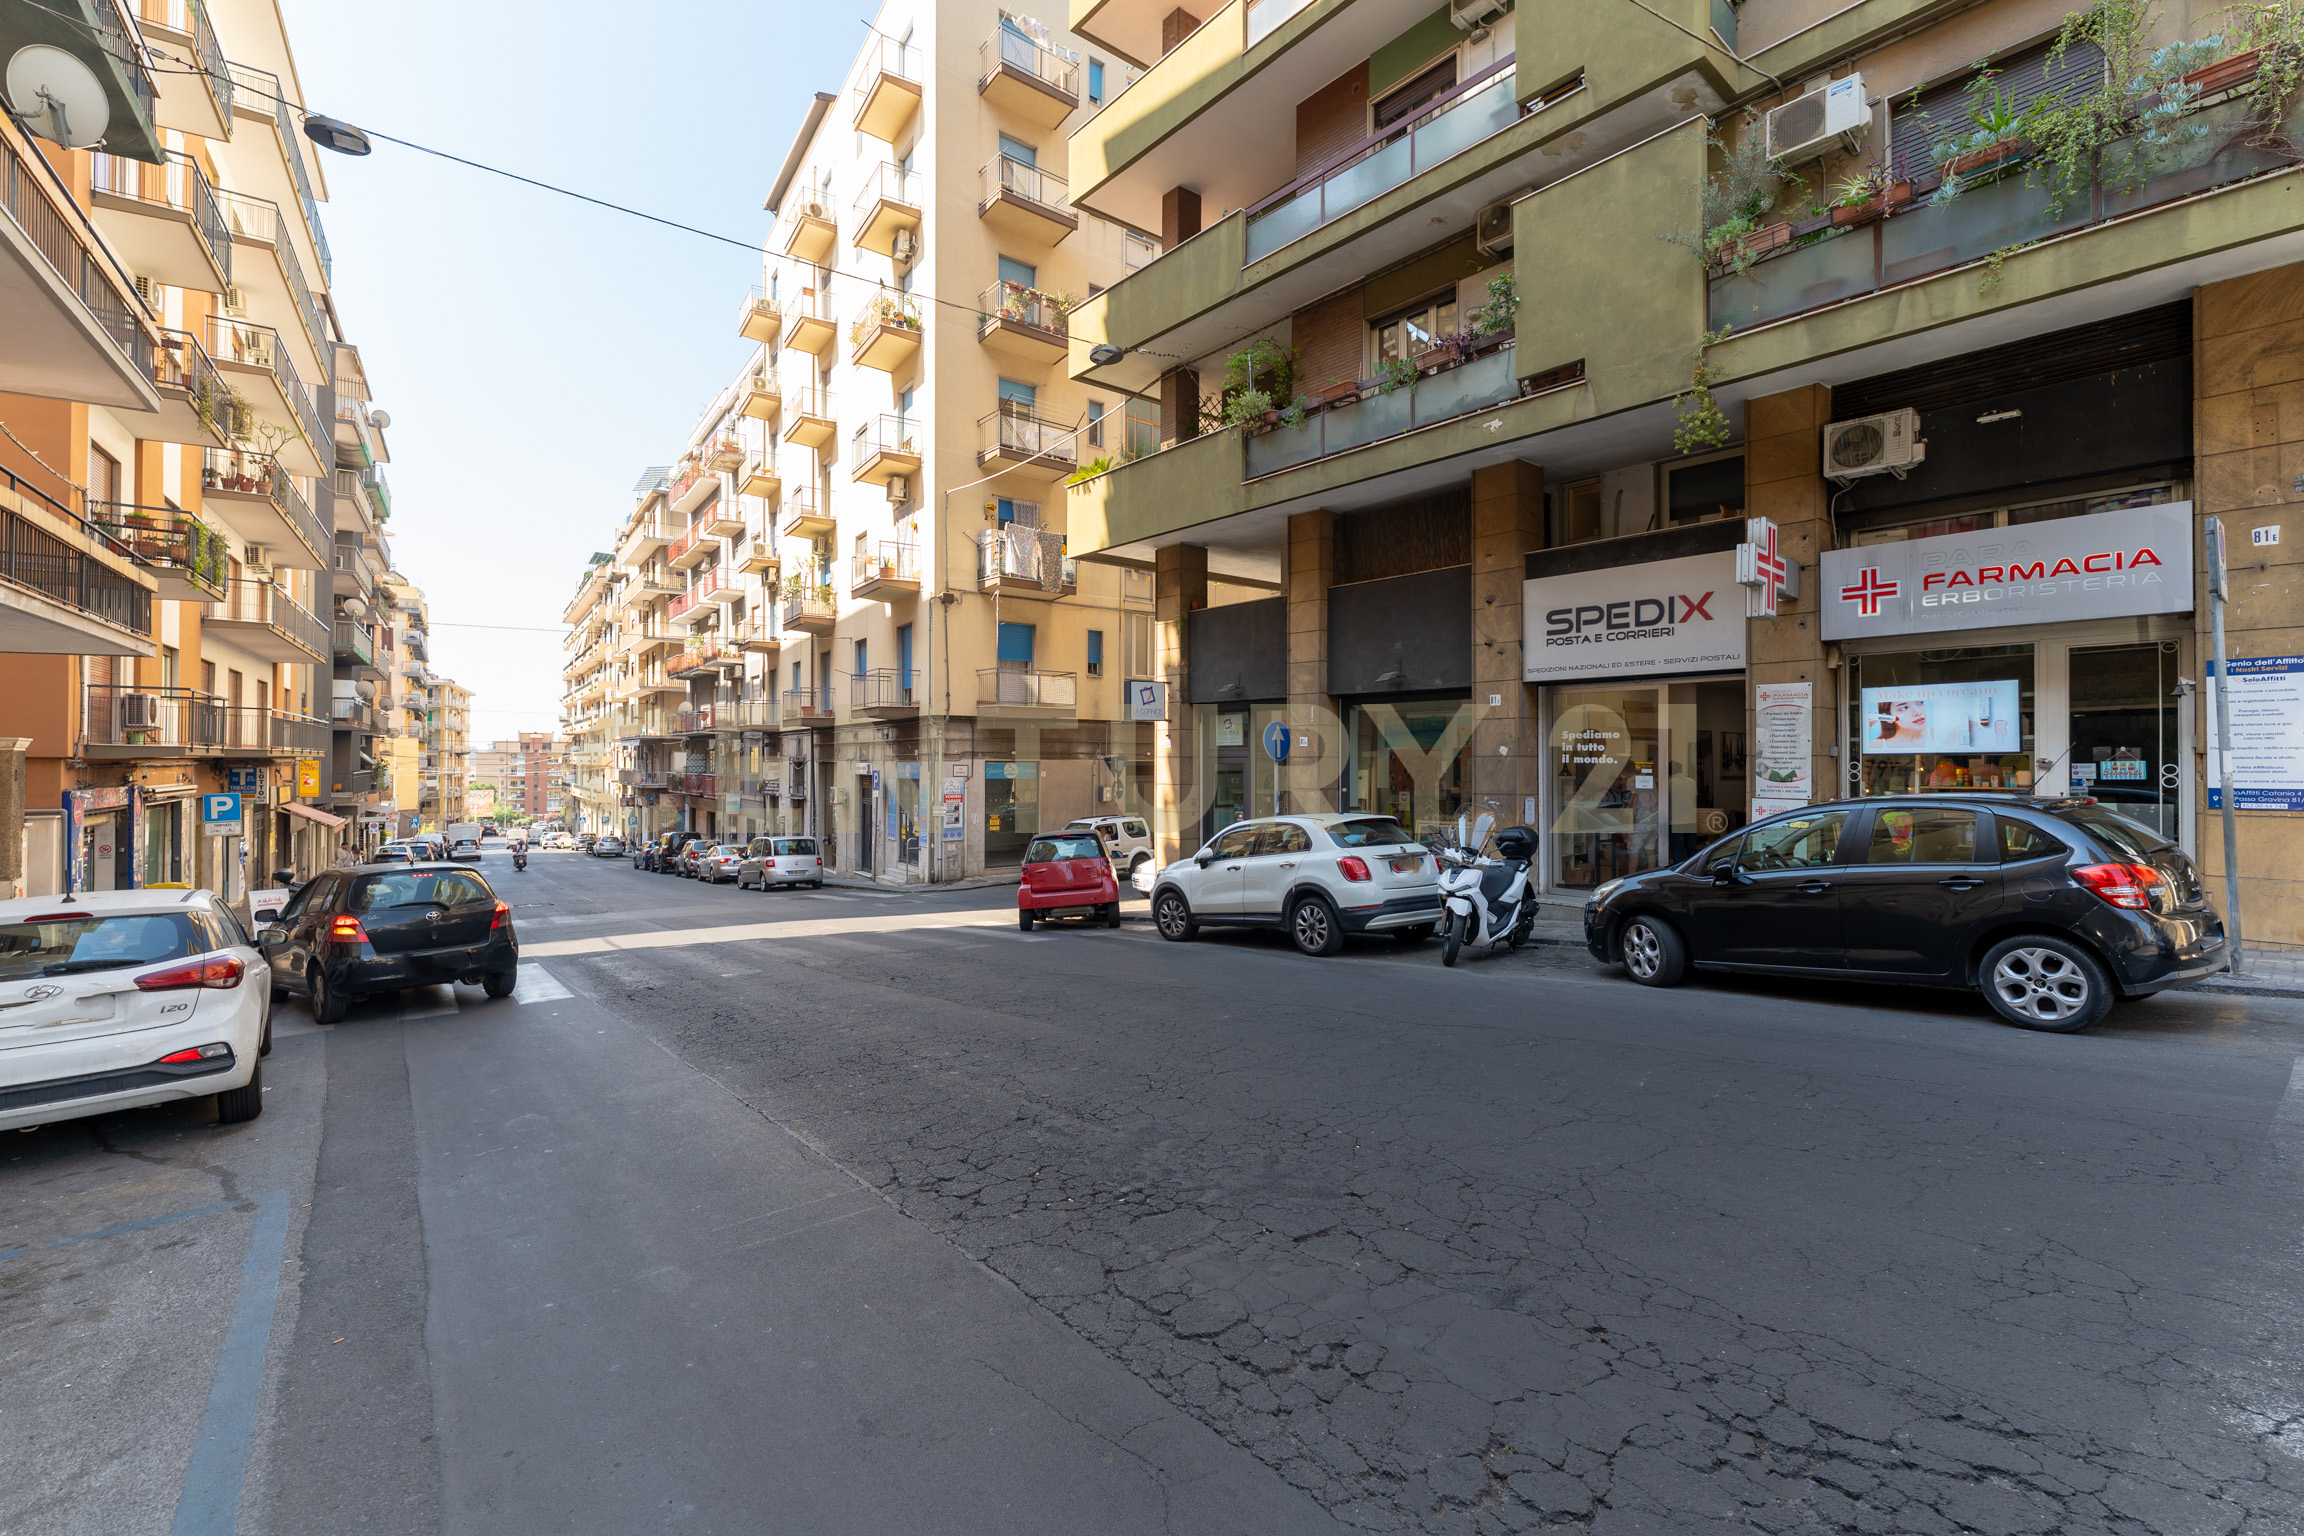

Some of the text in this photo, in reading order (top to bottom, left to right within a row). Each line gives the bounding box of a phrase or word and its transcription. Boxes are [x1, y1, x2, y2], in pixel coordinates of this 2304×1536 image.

[1921, 539, 2041, 571] PARA
[1922, 547, 2163, 592] FARMACIA
[1921, 571, 2164, 607] ERBORISTERIA
[1545, 590, 1716, 636] SPEDIX
[1546, 626, 1675, 647] POSTA E CORRIERI
[1526, 665, 1567, 674] SPEDIZIONI
[1568, 662, 1610, 672] NAZIONALI
[1611, 661, 1623, 669] ED
[1624, 658, 1656, 668] ESTERE
[1663, 656, 1699, 665] SERVIZI
[1700, 653, 1741, 663] POSTALI
[2225, 660, 2253, 668] Genio
[2260, 664, 2288, 672] Servizi
[2242, 675, 2286, 683] SoloAffitti
[1877, 686, 1998, 700] Make up coreano
[1561, 729, 1620, 741] Spediamo
[1561, 742, 1606, 752] in tutto
[1561, 753, 1618, 764] il mondo.
[232, 768, 254, 785] T
[873, 772, 879, 788] P
[210, 796, 234, 819] P
